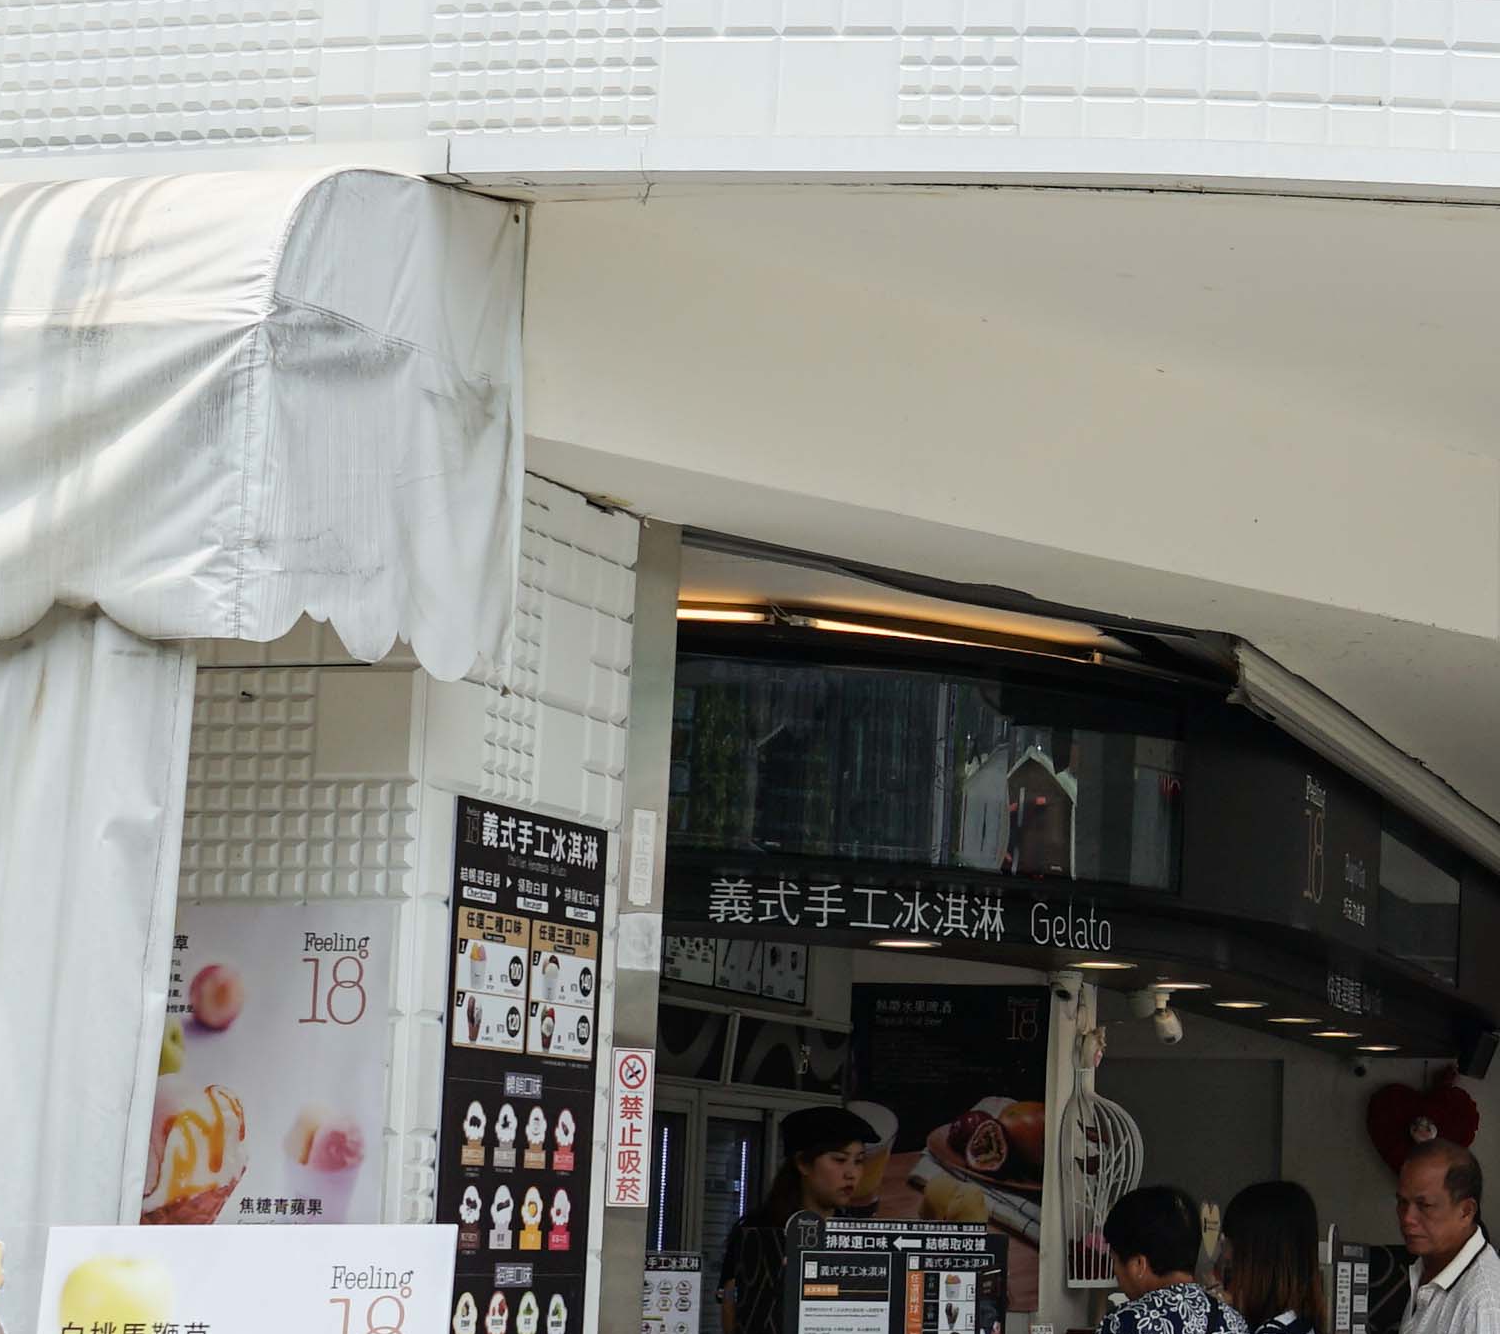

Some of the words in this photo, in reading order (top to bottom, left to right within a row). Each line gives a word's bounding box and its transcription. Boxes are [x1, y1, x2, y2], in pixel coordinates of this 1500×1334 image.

[482, 810, 598, 870] 義式手工冰淇淋
[708, 878, 1005, 942] 義式手工冰淇淋
[1030, 901, 1112, 951] Gelato
[304, 933, 369, 952] Feeling
[299, 956, 366, 1025] 18
[616, 1095, 644, 1201] 禁止吸菸
[240, 1197, 323, 1216] 焦糖青蘋果
[826, 1235, 888, 1249] 排隊選口味
[331, 1265, 413, 1290] Feeling
